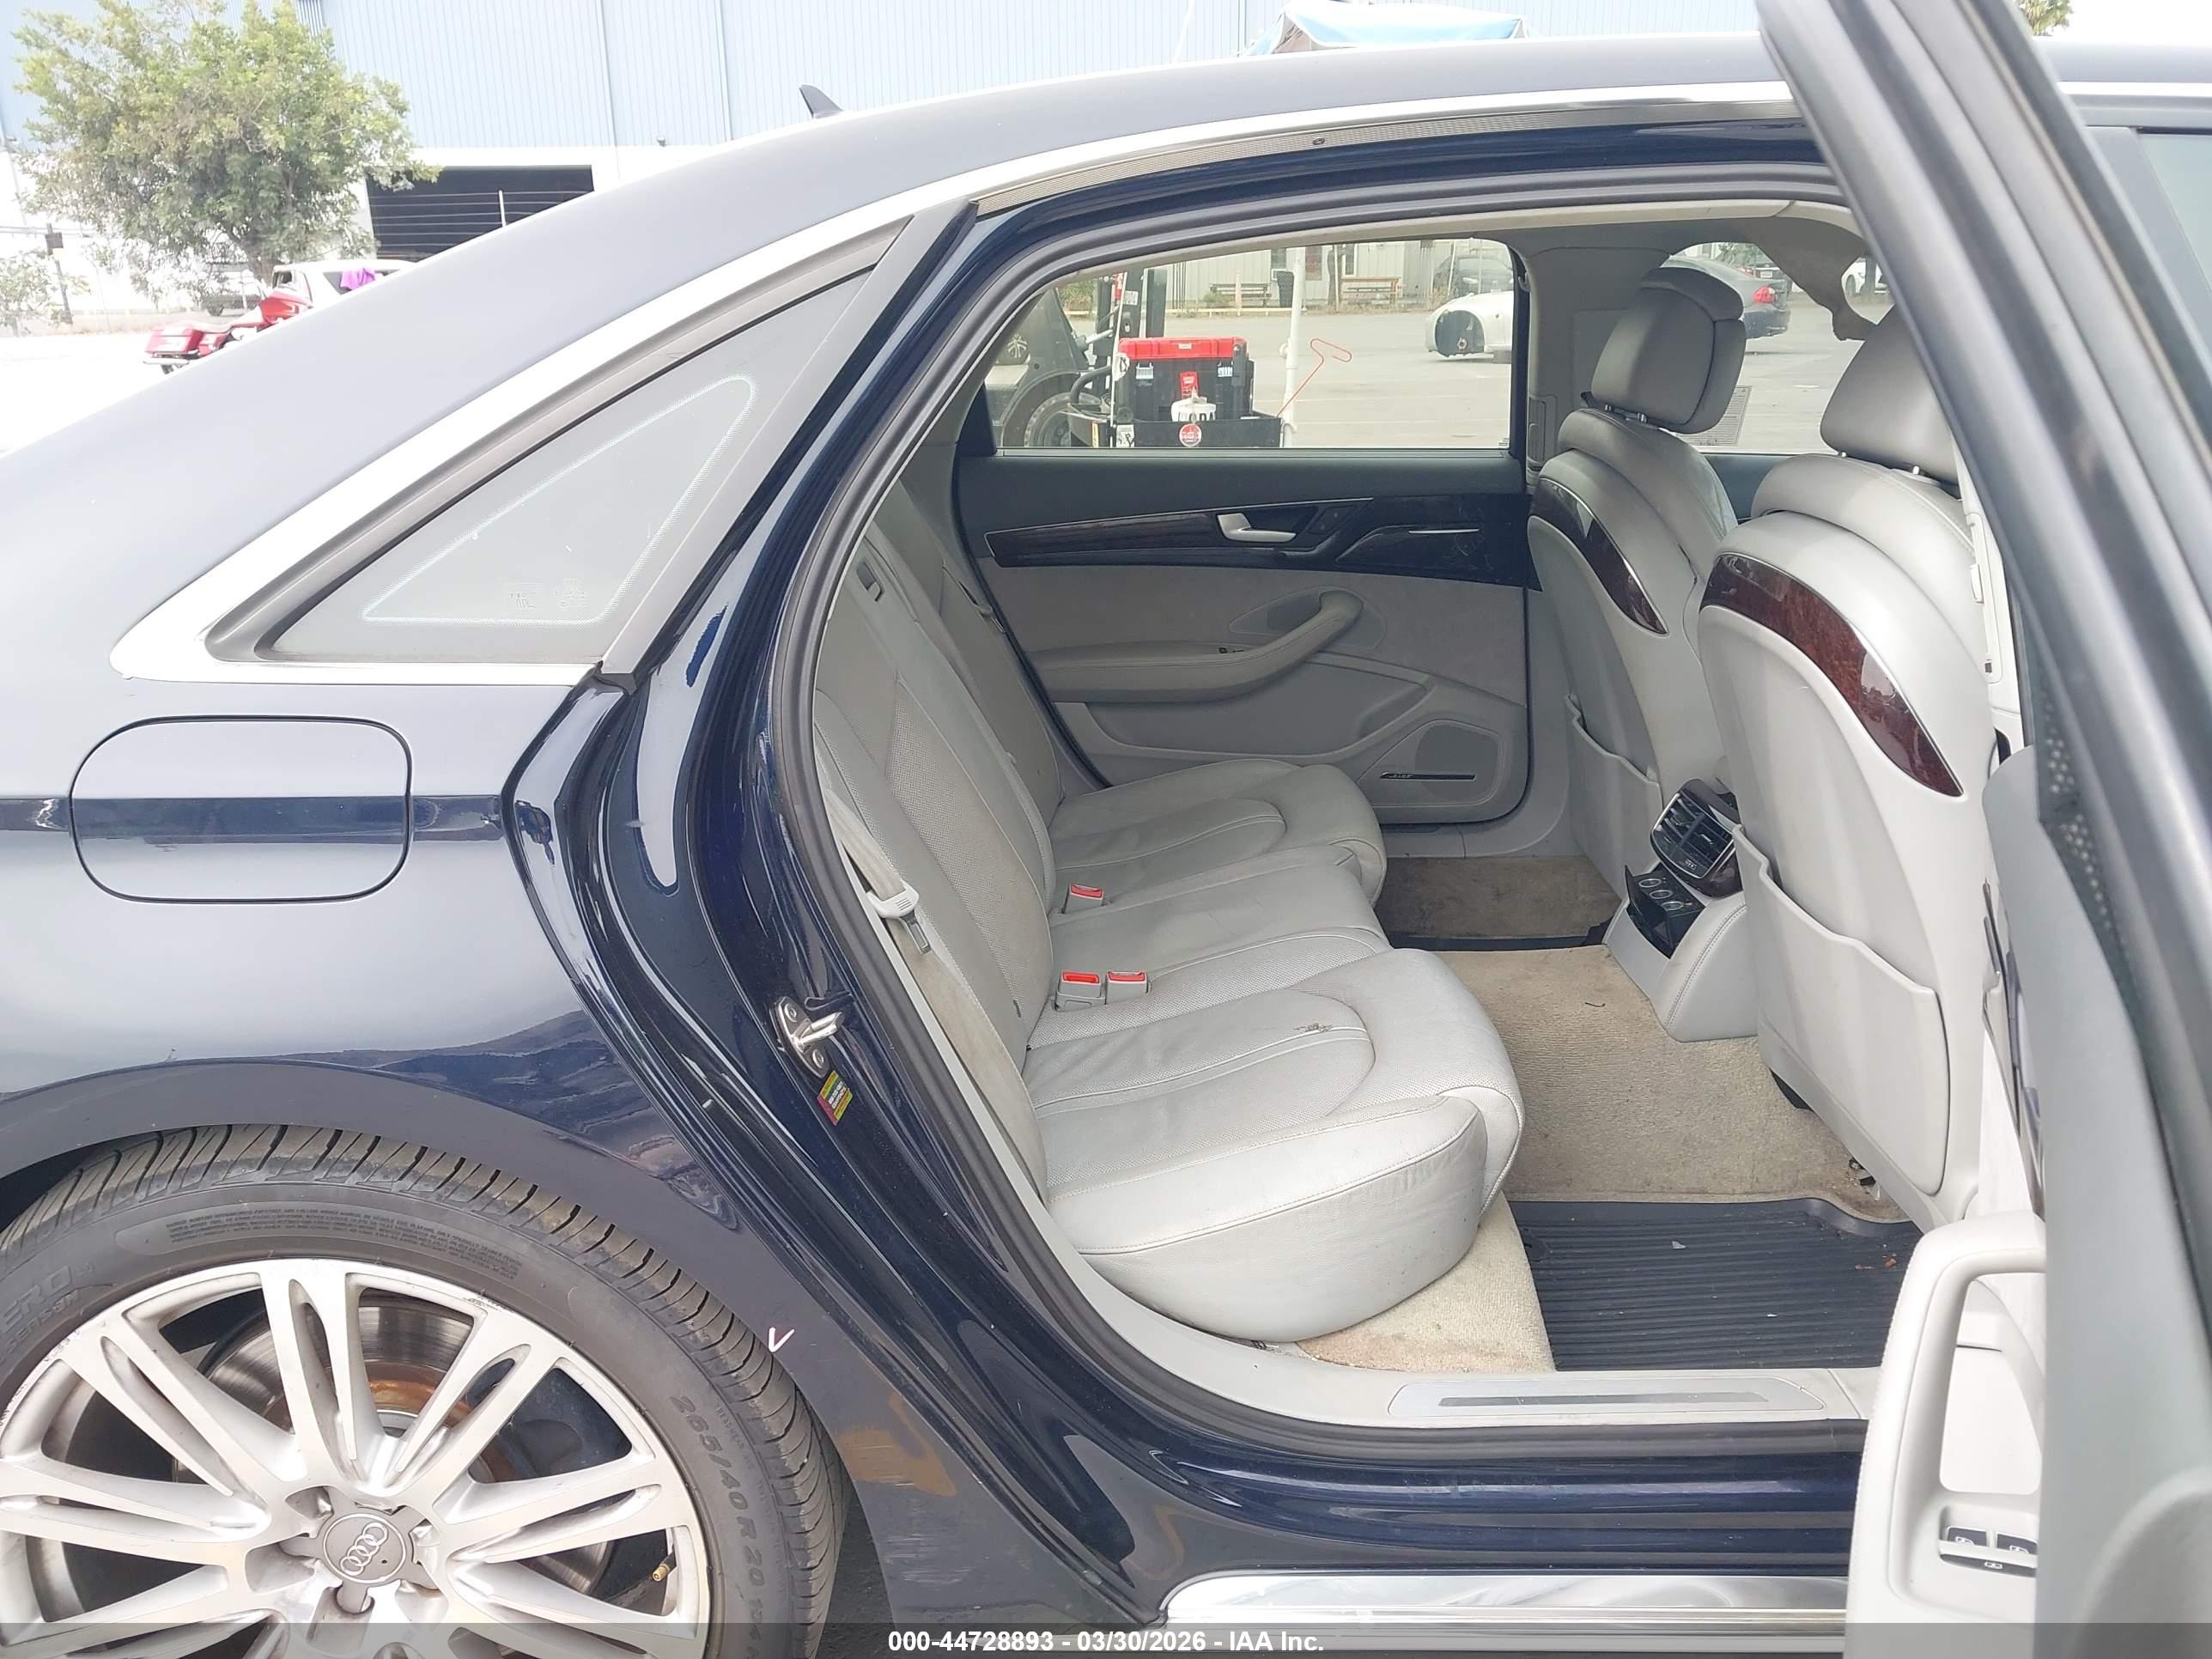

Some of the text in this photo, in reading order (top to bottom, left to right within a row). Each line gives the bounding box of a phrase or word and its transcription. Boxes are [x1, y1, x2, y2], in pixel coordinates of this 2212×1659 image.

[669, 1395, 749, 1510] 265/40
[737, 1516, 758, 1540] R
[744, 1546, 765, 1587] 20
